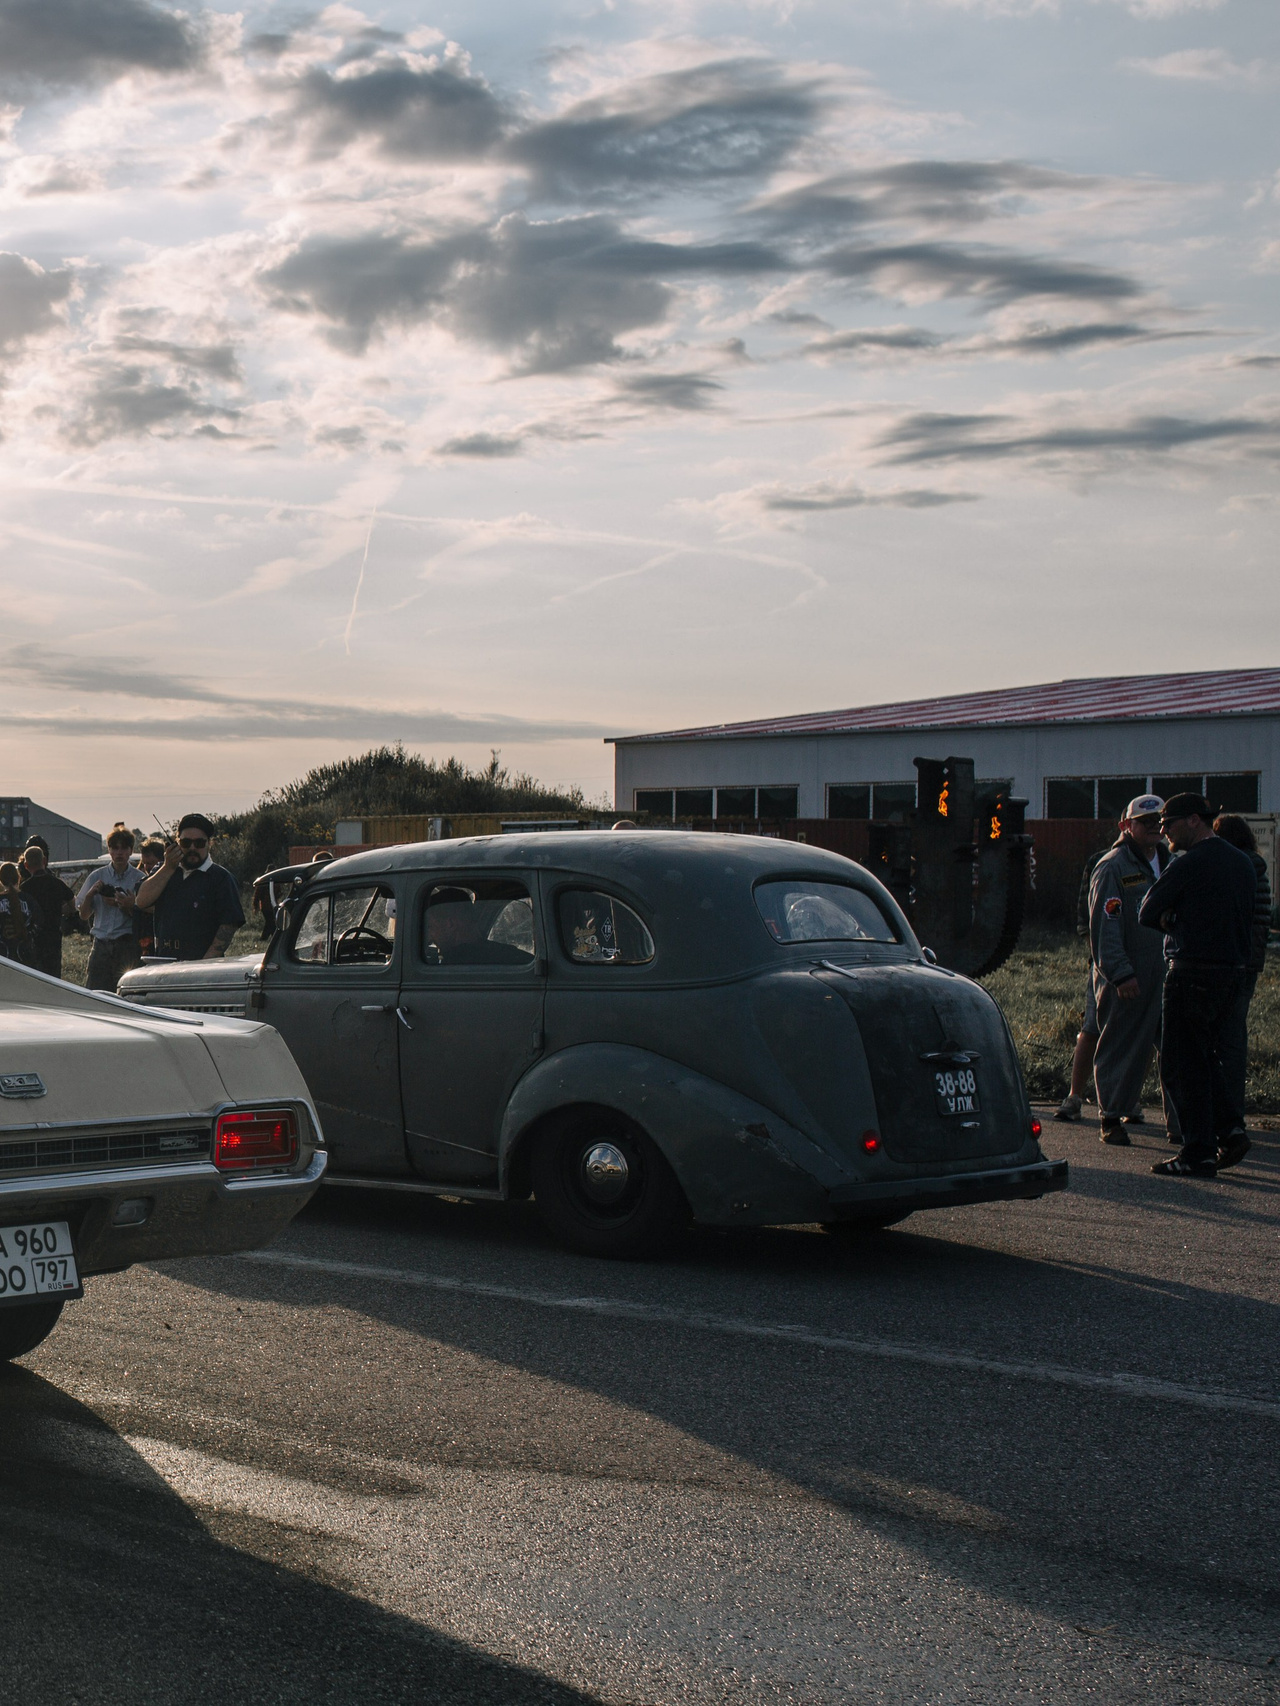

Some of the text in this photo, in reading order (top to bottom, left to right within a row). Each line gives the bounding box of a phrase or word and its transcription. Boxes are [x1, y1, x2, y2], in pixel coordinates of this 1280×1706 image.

[935, 1069, 976, 1097] 38-88
[14, 1226, 57, 1257] 960
[35, 1259, 68, 1284] 797
[48, 1282, 62, 1290] RUS
